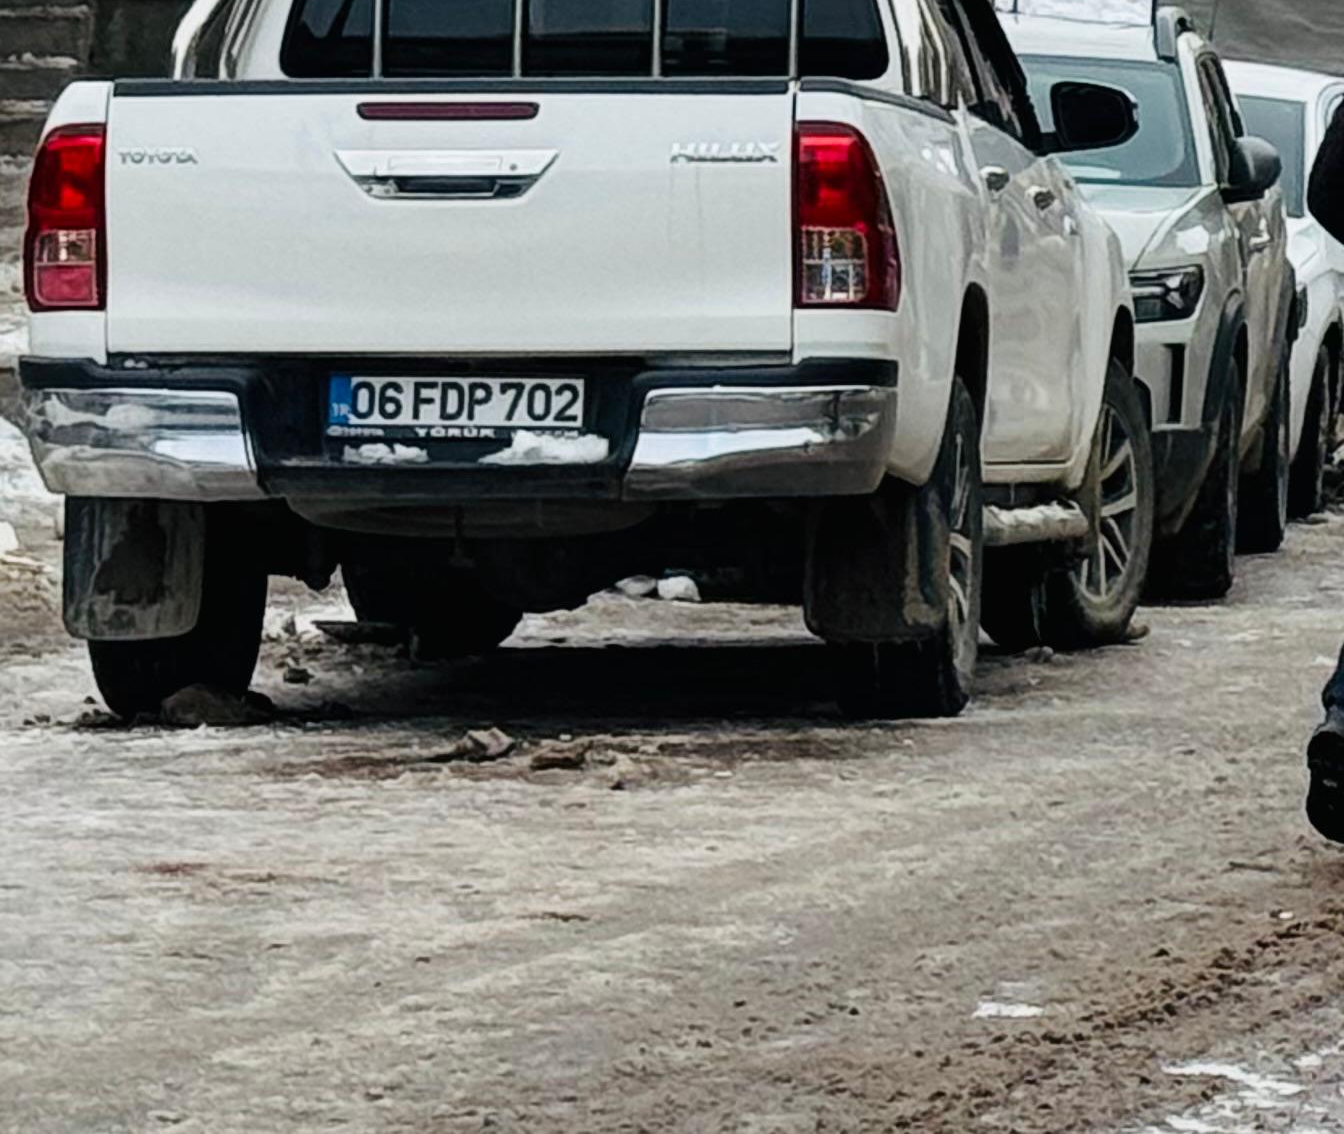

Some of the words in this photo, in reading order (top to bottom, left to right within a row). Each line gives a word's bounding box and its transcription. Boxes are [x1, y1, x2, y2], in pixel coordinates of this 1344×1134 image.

[119, 151, 199, 165] TOYOTA
[670, 142, 779, 163] HILUX
[351, 380, 404, 420] 06
[412, 381, 493, 422] FDP
[500, 382, 579, 423] 702
